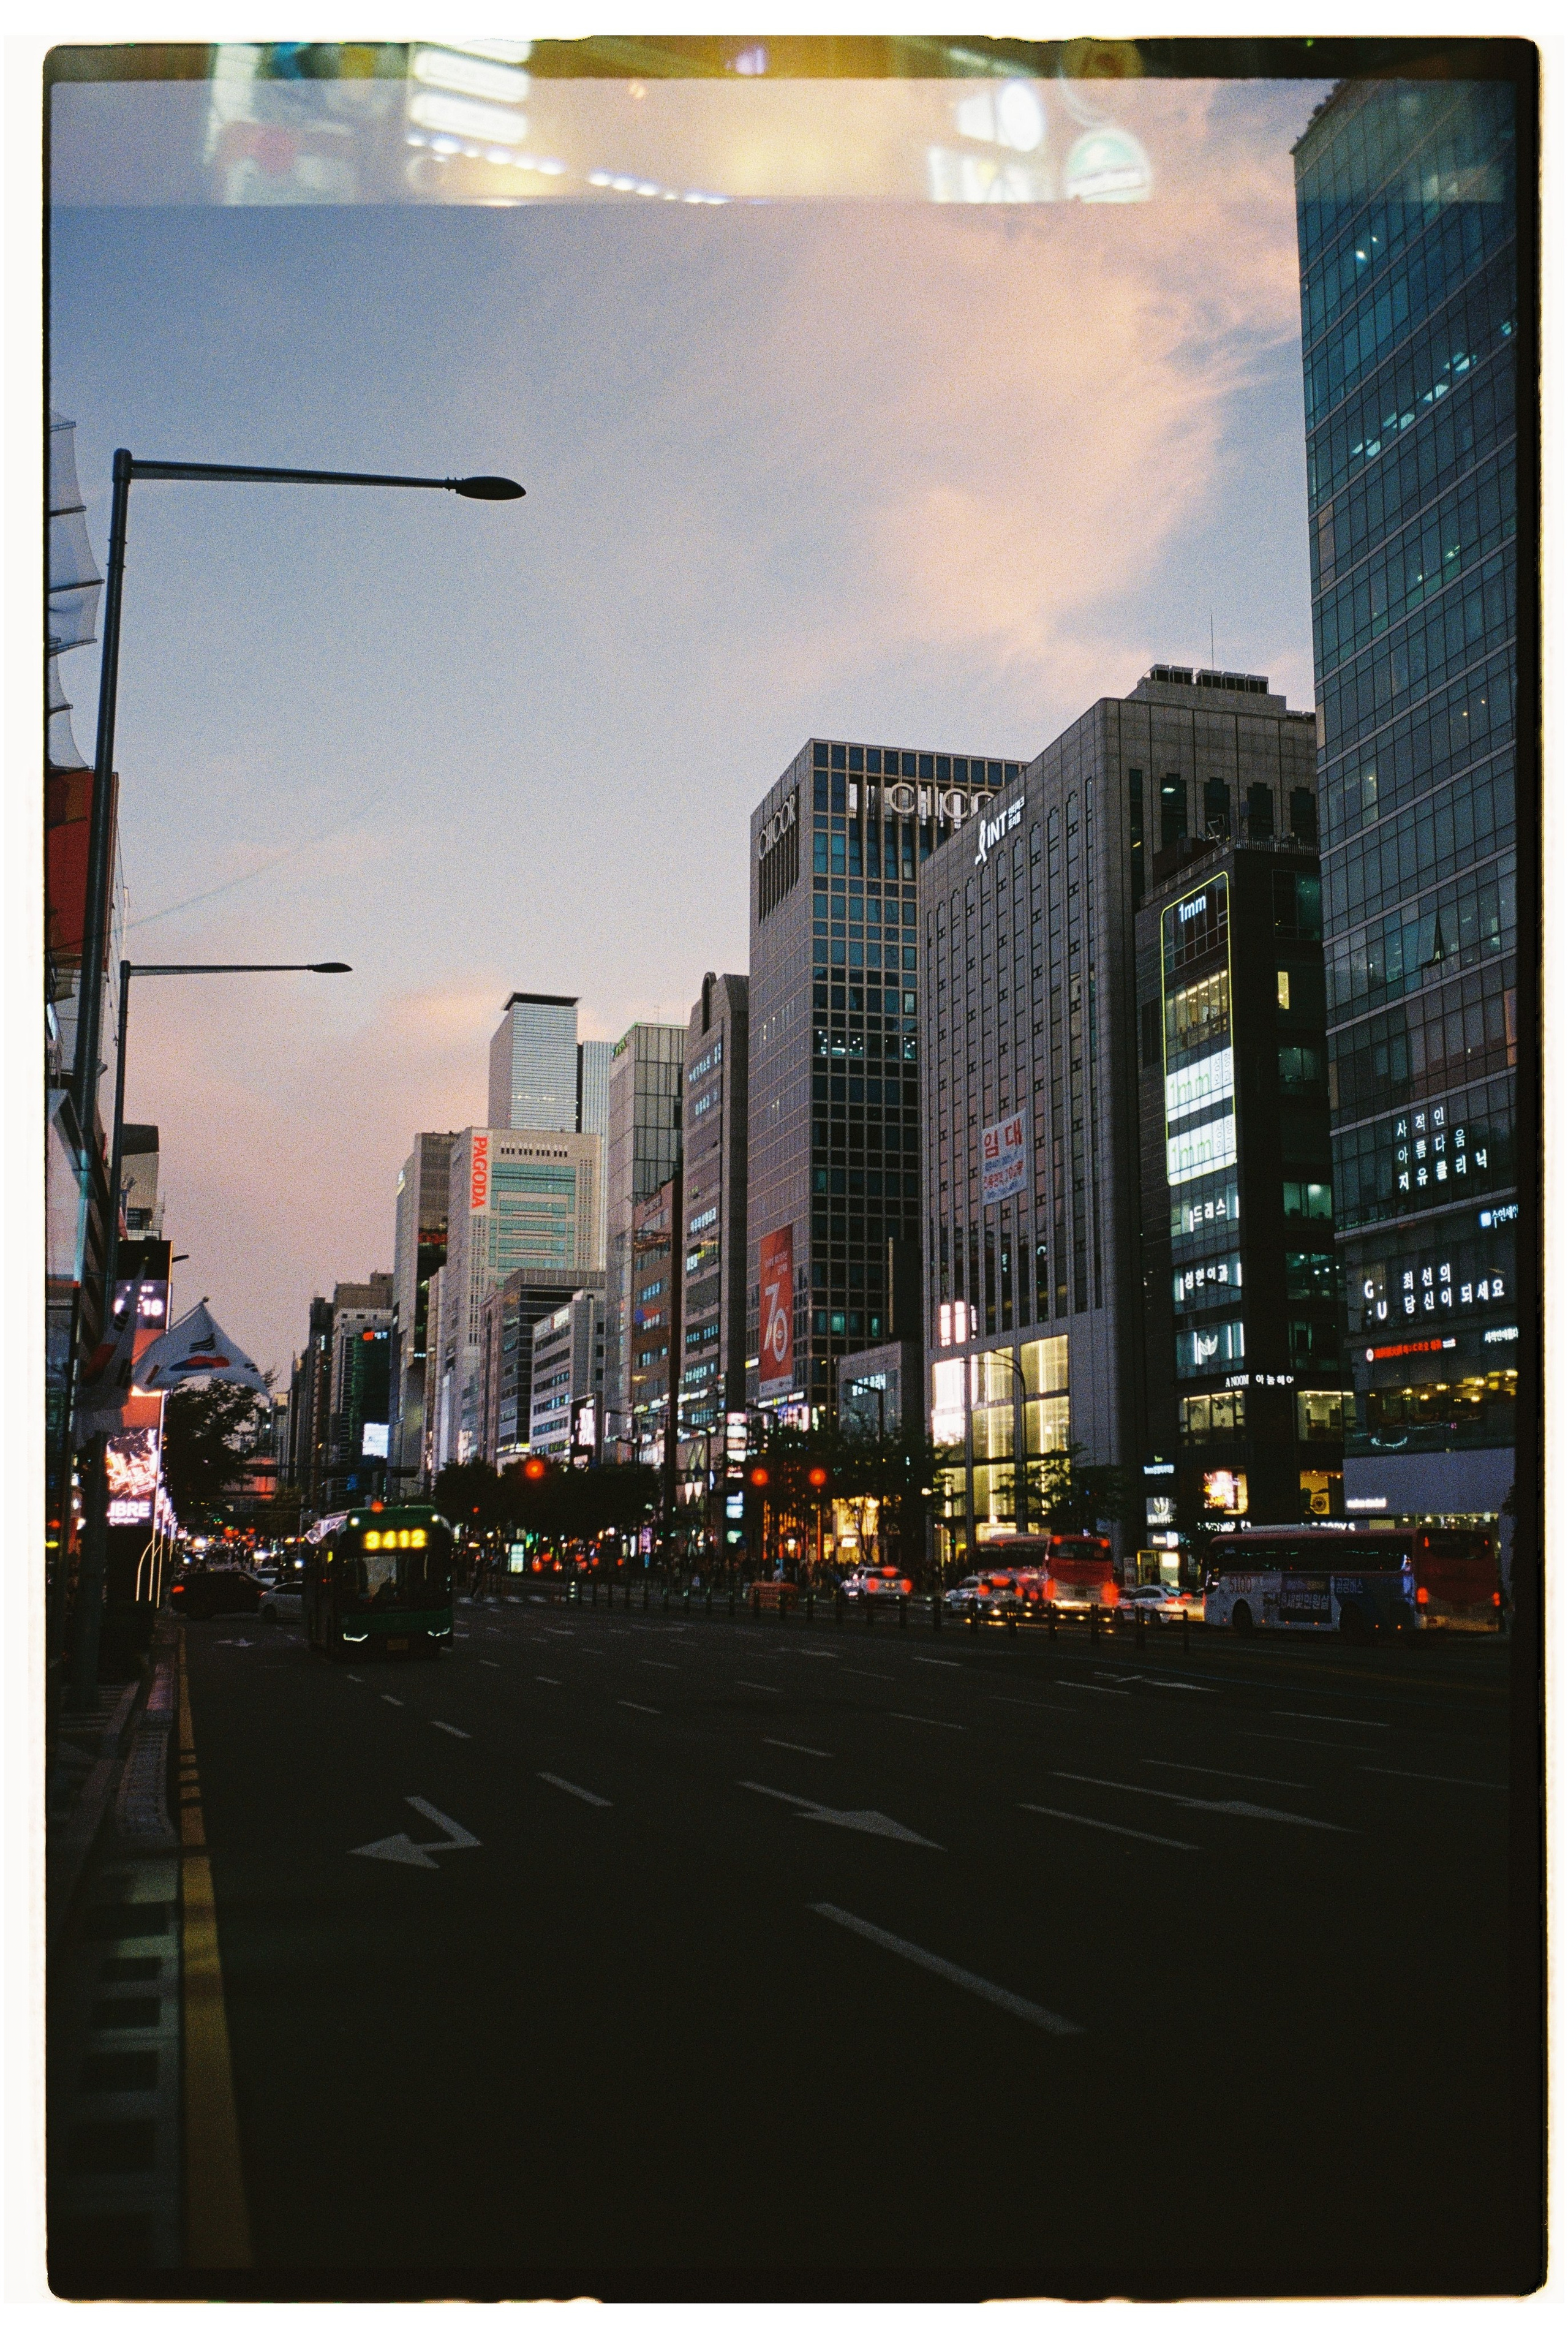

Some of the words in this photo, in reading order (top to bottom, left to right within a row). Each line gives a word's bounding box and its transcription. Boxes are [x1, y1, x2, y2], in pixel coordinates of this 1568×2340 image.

[1178, 895, 1206, 922] 1mm
[1170, 1074, 1210, 1107] 1mm
[1397, 1106, 1444, 1138] 사적인
[1172, 1139, 1212, 1169] 1mm
[1398, 1129, 1465, 1164] 아름다움
[471, 1136, 488, 1209] PAGODA
[1399, 1149, 1488, 1191] 지유클리닉
[1403, 1263, 1451, 1289] 최선의
[1404, 1287, 1452, 1315] 당신이
[1461, 1278, 1504, 1303] 되세요
[364, 1530, 426, 1549] 3412
